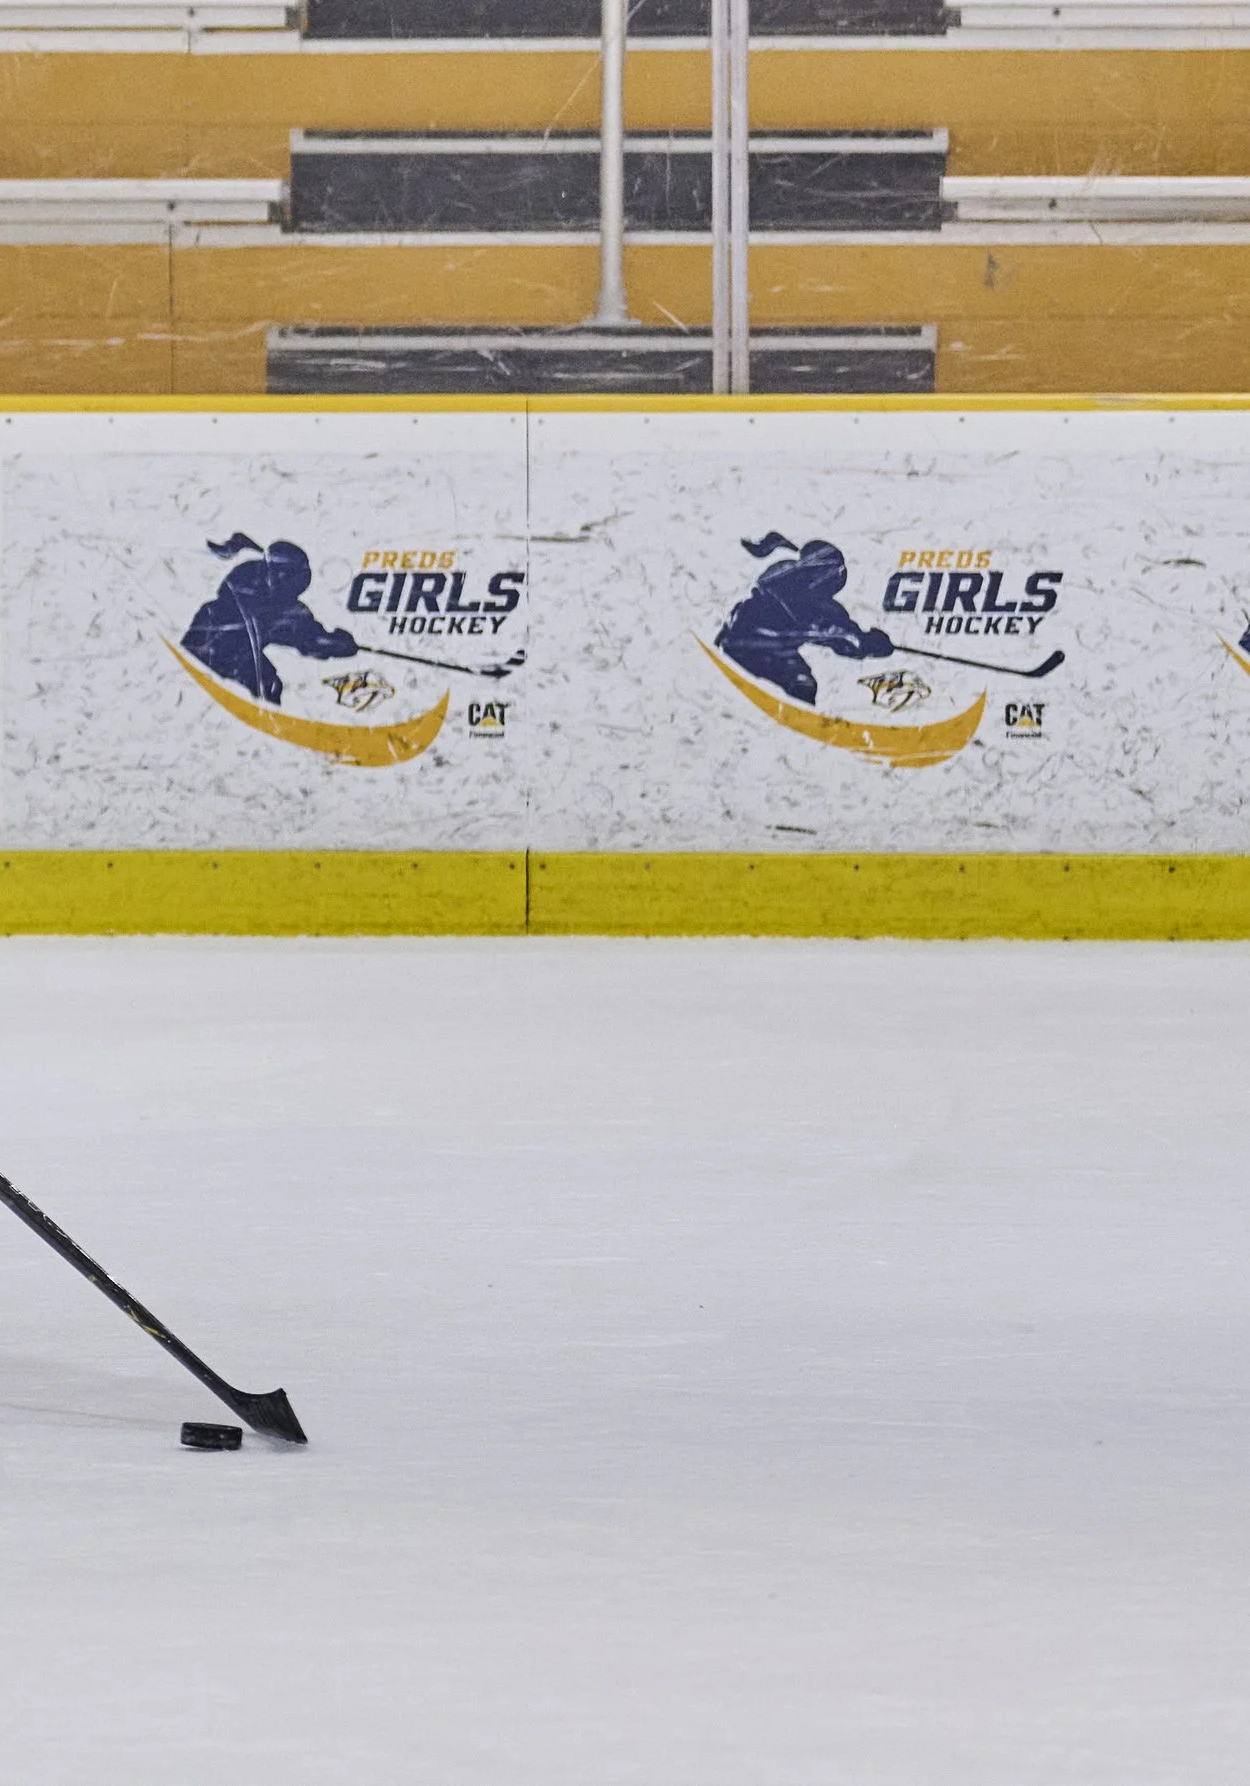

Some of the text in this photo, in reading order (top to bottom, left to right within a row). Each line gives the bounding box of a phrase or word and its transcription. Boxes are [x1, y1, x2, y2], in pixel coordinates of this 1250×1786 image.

[362, 551, 456, 569] PREDS
[899, 551, 992, 569] PREDS
[347, 572, 525, 612] GIRLS
[882, 572, 1063, 612] GIRLS
[389, 616, 507, 634] HOCKEY
[925, 616, 1043, 634] HOCKEY
[468, 703, 509, 726] CAT
[1005, 703, 1045, 726] CAT
